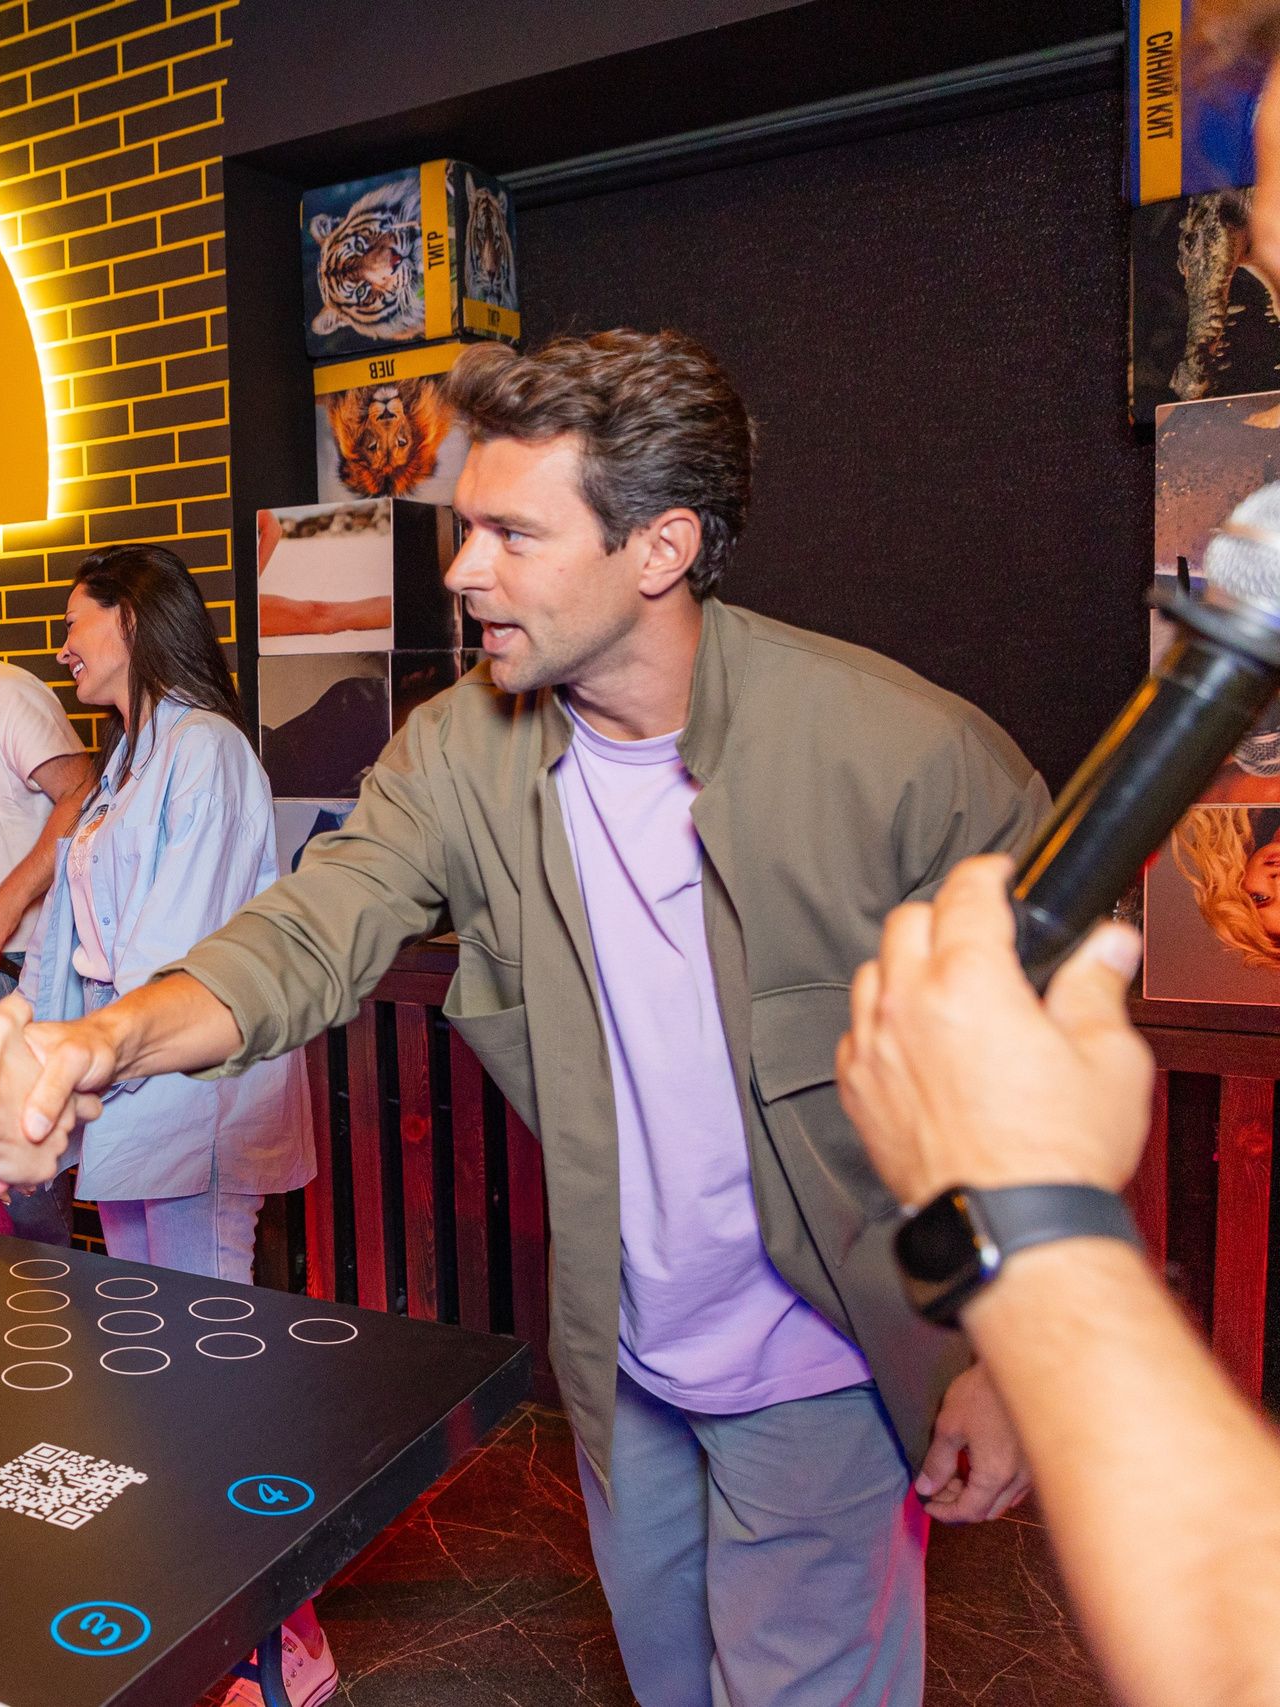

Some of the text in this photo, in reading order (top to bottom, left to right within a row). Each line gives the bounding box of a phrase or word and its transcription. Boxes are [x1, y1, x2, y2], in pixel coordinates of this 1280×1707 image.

[1147, 31, 1179, 139] СИНИЙ КИТ
[427, 230, 446, 270] ТИГР
[369, 358, 395, 379] ЛЕВ
[258, 1482, 290, 1504] 4
[79, 1611, 121, 1646] 3
